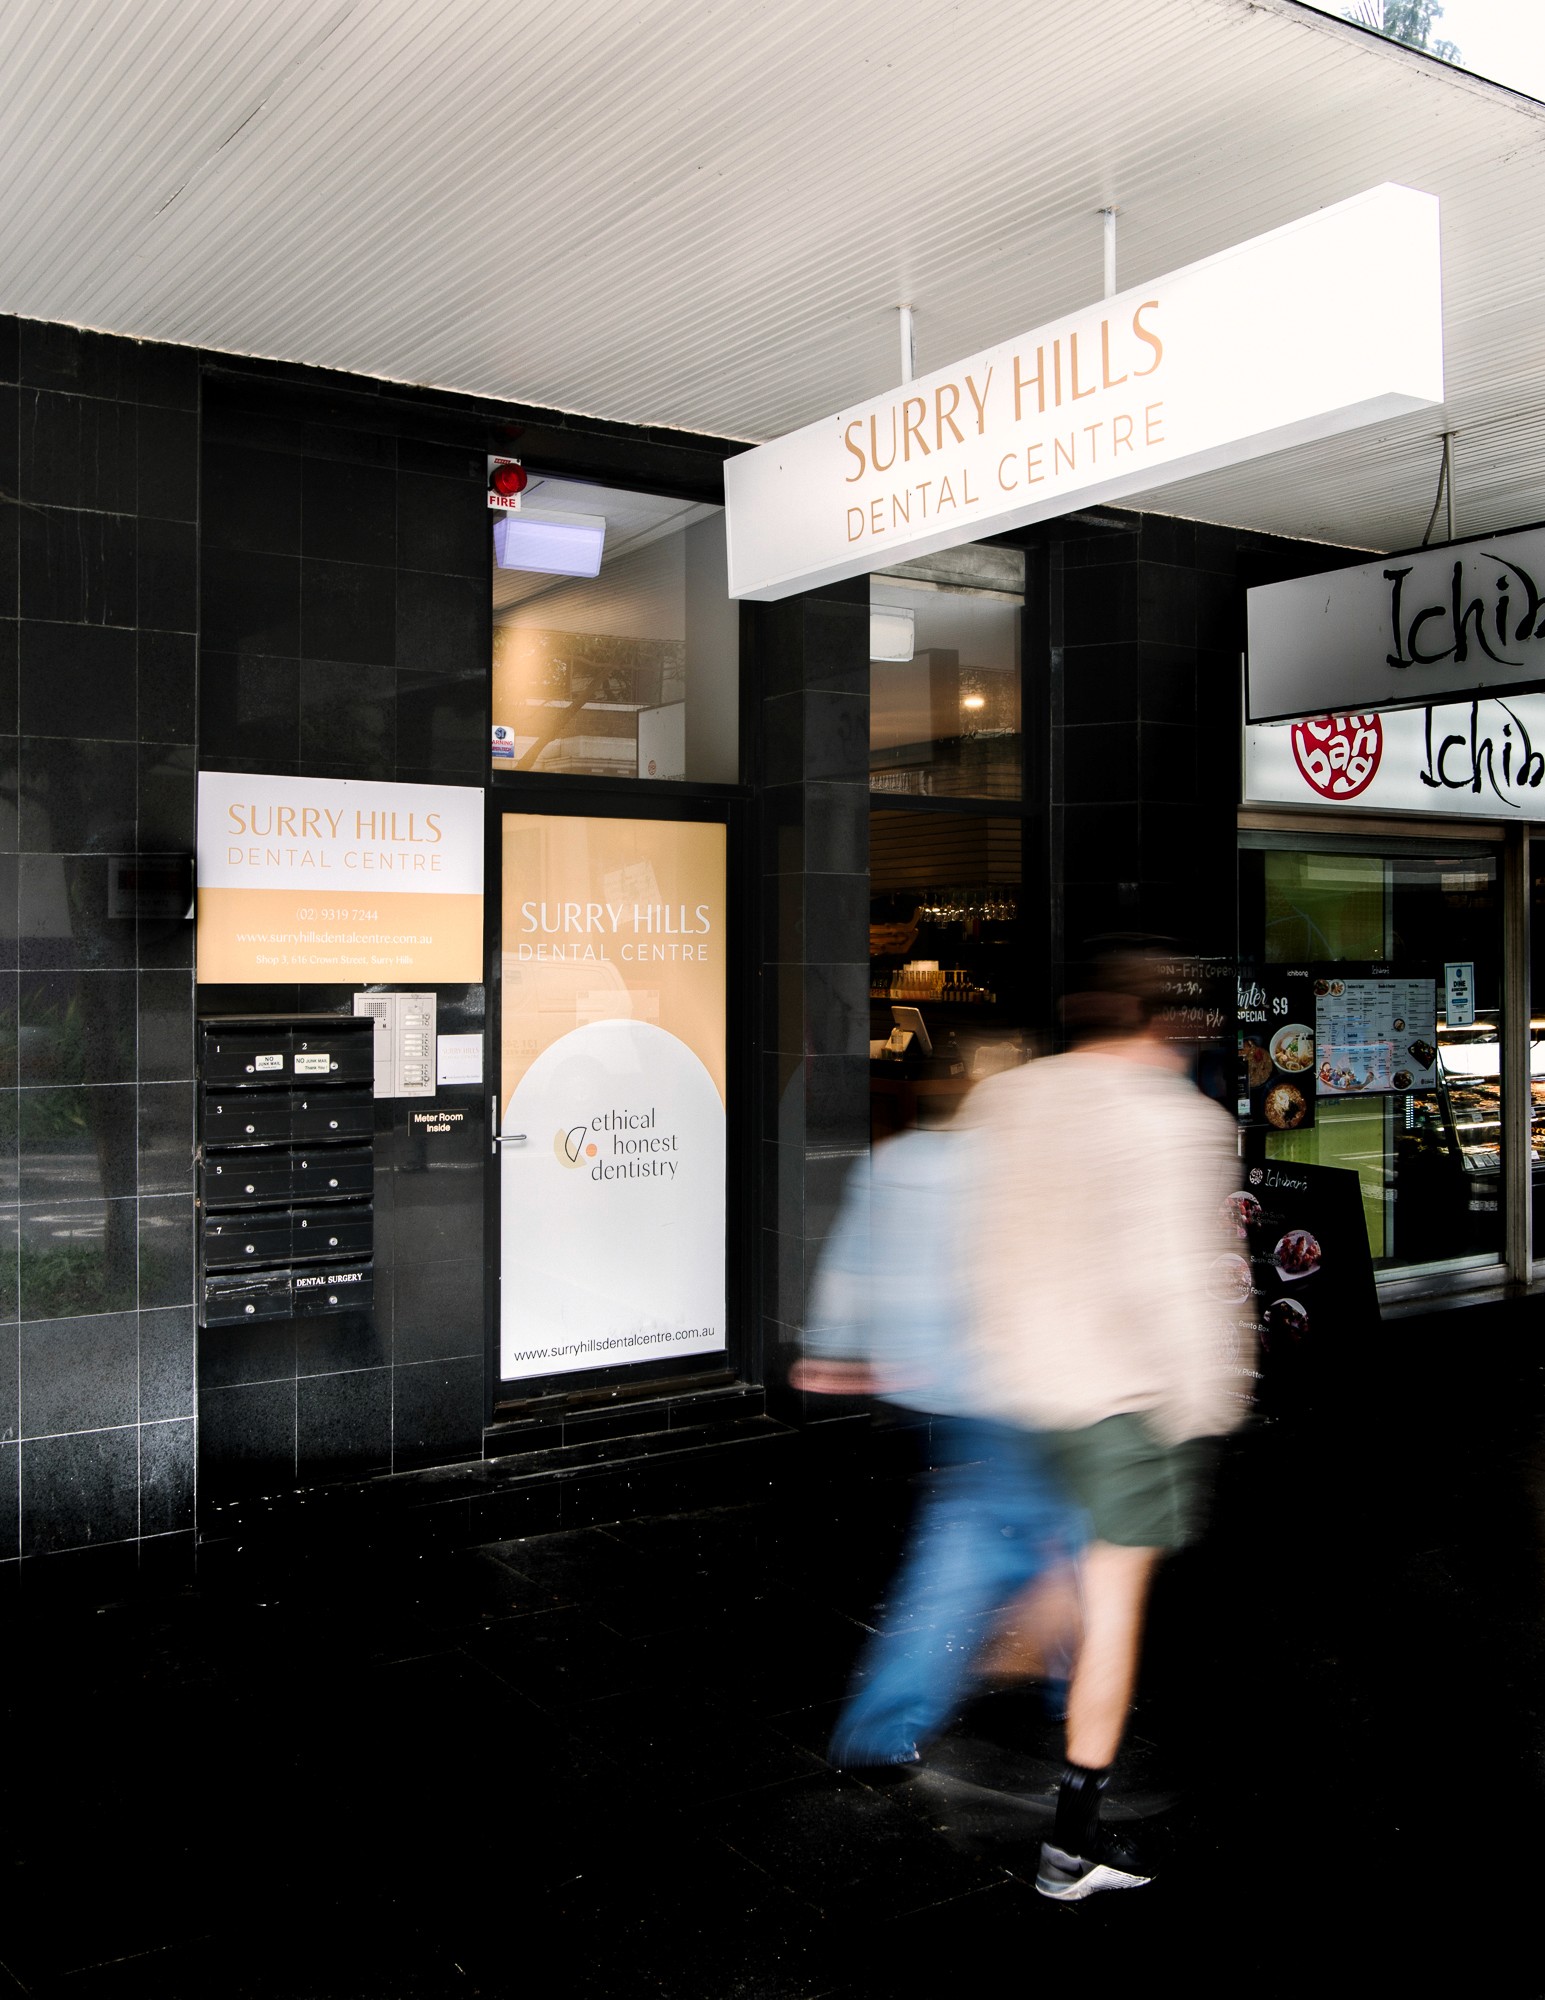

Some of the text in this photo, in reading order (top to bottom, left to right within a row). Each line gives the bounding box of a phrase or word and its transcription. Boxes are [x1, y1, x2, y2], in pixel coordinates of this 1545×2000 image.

[845, 300, 1164, 483] SURRY HILLS
[847, 401, 1165, 542] DENTAL CENTRE
[489, 495, 516, 508] FIRE
[228, 803, 442, 843] SURRY HILLS
[228, 847, 442, 872] DENTAL CENTRE
[296, 908, 378, 922] (02) 9319 7244
[521, 902, 711, 934] SURRY HILLS
[236, 931, 432, 948] www.surryhillsdentalcentre.com.au
[518, 943, 708, 961] DENTAL CENTRE
[256, 955, 279, 965] Shop
[291, 955, 307, 964] 616
[309, 955, 338, 964] Crown
[370, 956, 394, 966] Surry
[396, 955, 413, 965] Hills
[1272, 997, 1289, 1016] $9
[216, 1045, 221, 1053] 1
[301, 1042, 308, 1050] 2
[216, 1106, 222, 1114] 3
[301, 1102, 308, 1110] 4
[414, 1112, 463, 1123] Meter Room
[591, 1107, 655, 1131] ethical
[426, 1123, 451, 1132] Inside
[613, 1134, 679, 1155] honest
[216, 1166, 222, 1174] 5
[301, 1161, 308, 1169] 6
[591, 1157, 679, 1181] dentistry
[216, 1227, 222, 1235] 7
[301, 1220, 308, 1228] 8
[296, 1273, 363, 1287] DENTAL SURGERY
[1239, 1319, 1270, 1332] Bento Box
[514, 1326, 715, 1362] www.surryhillsdentalcentre.com.au
